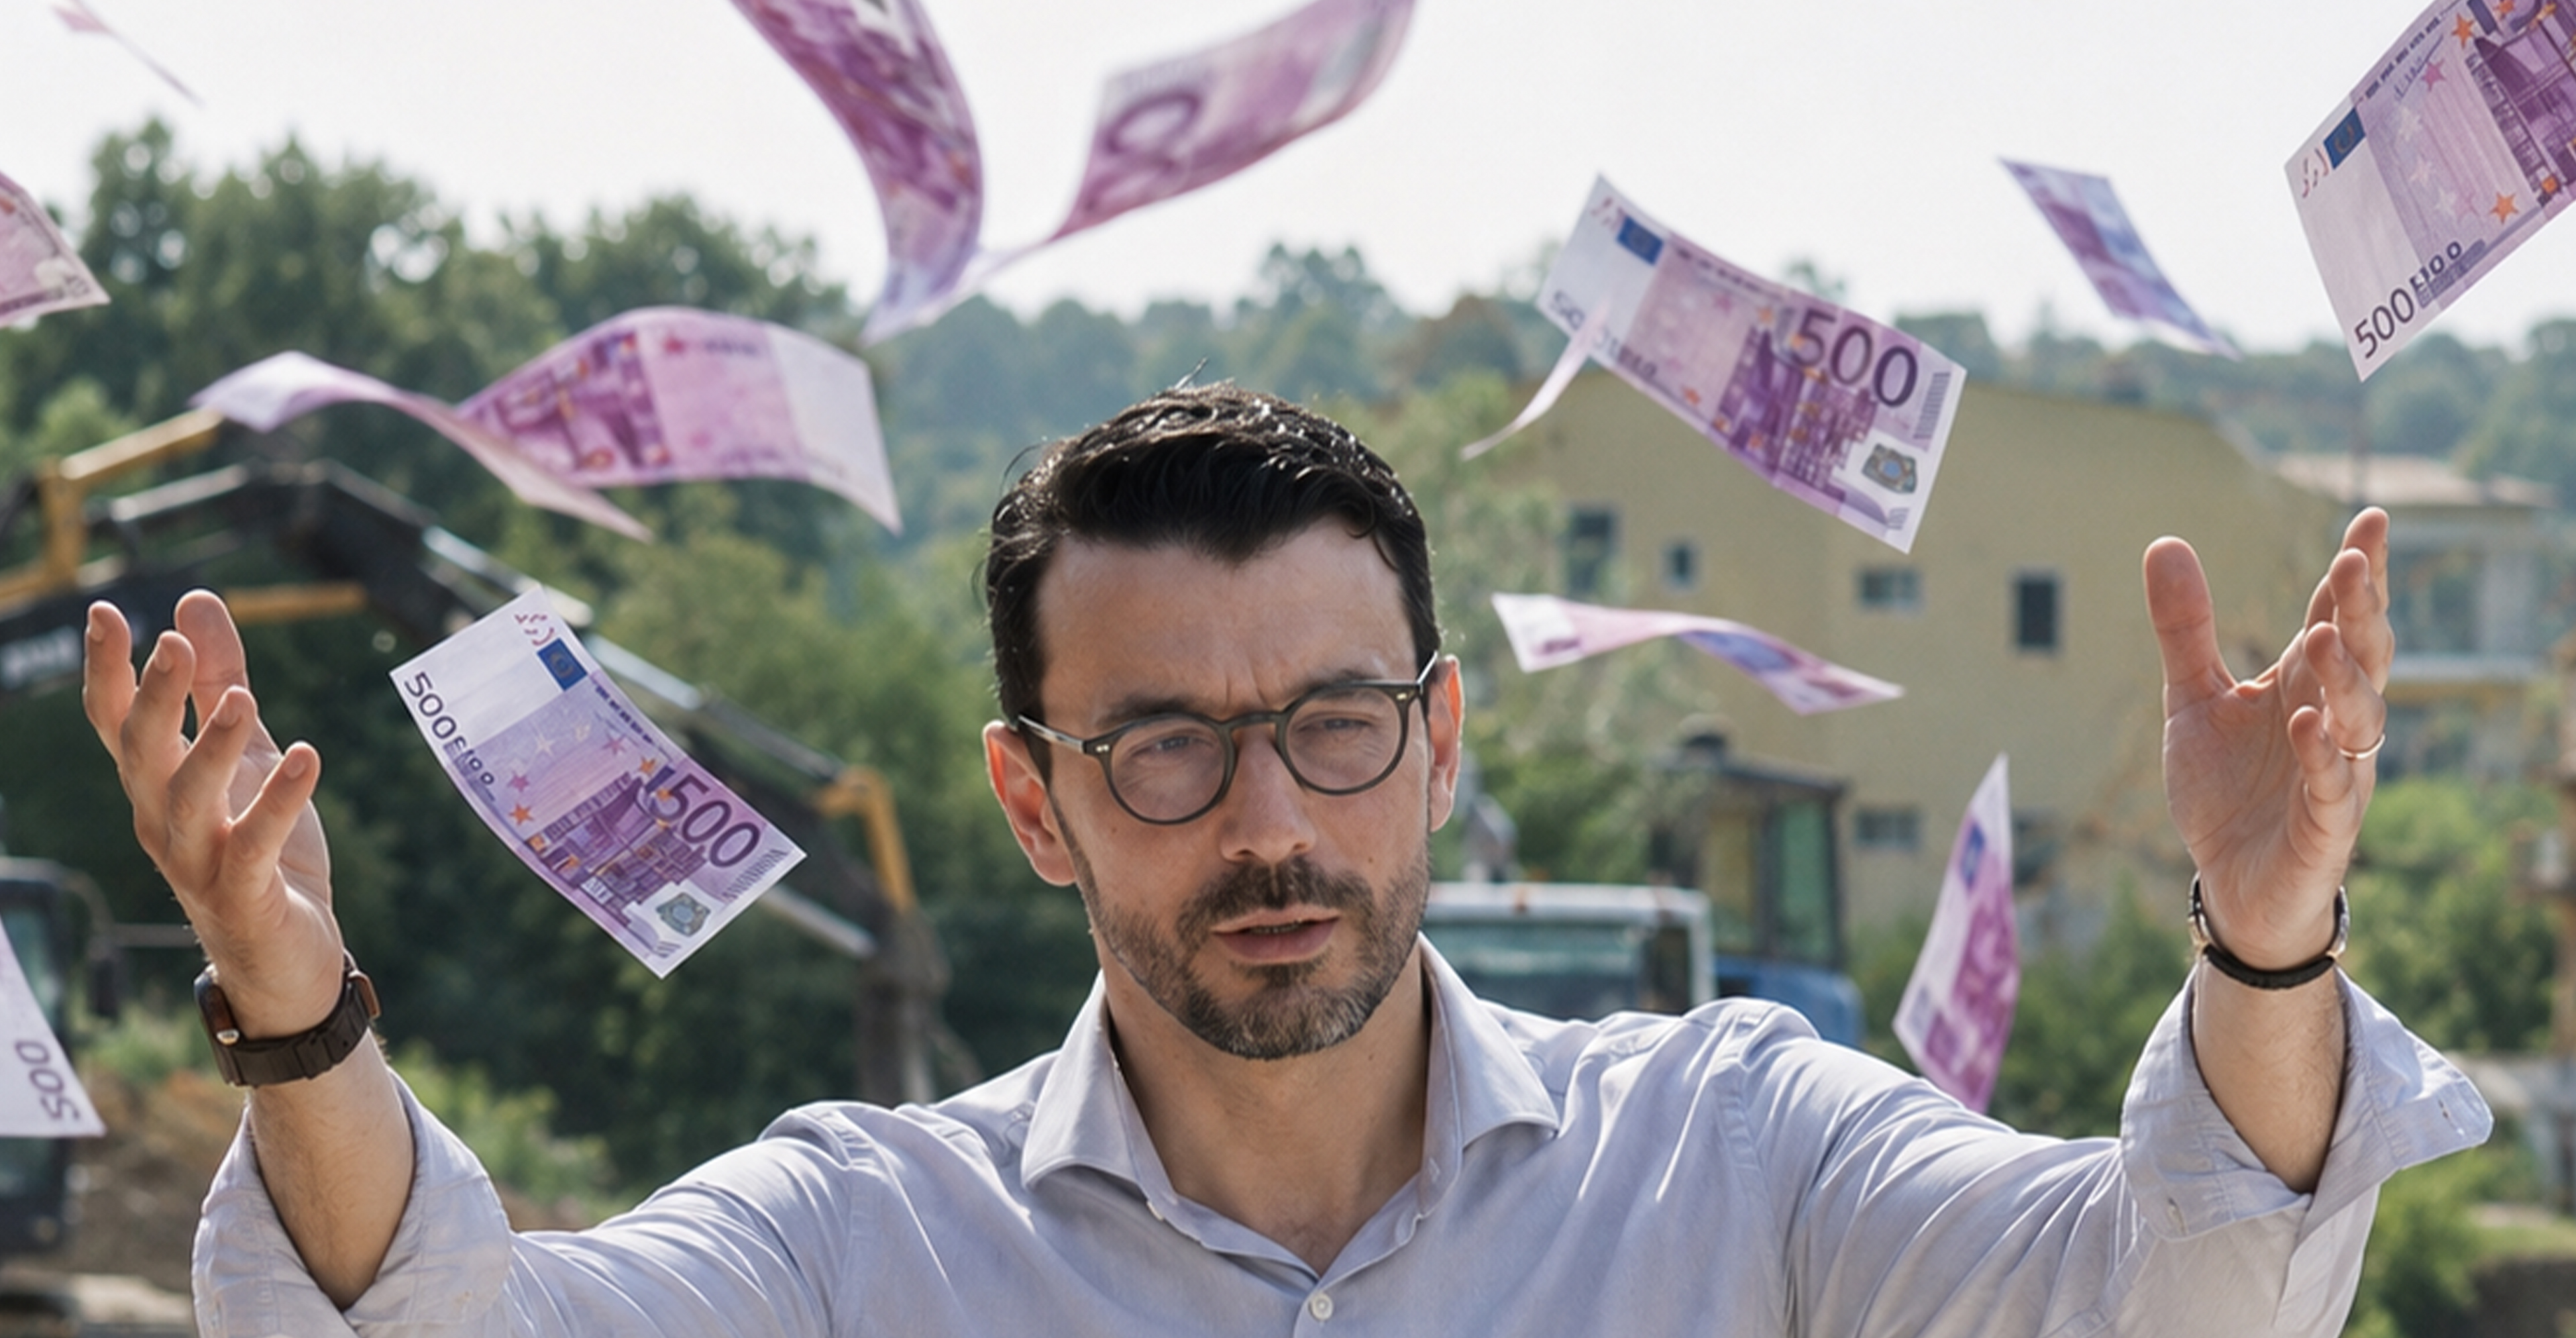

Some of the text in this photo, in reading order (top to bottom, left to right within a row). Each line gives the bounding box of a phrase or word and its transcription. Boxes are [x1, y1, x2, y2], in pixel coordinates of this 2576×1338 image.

[1790, 308, 1918, 408] 500
[2355, 288, 2414, 359] 500
[404, 671, 457, 739] 500
[649, 773, 761, 868] 500
[15, 1039, 80, 1121] 500
